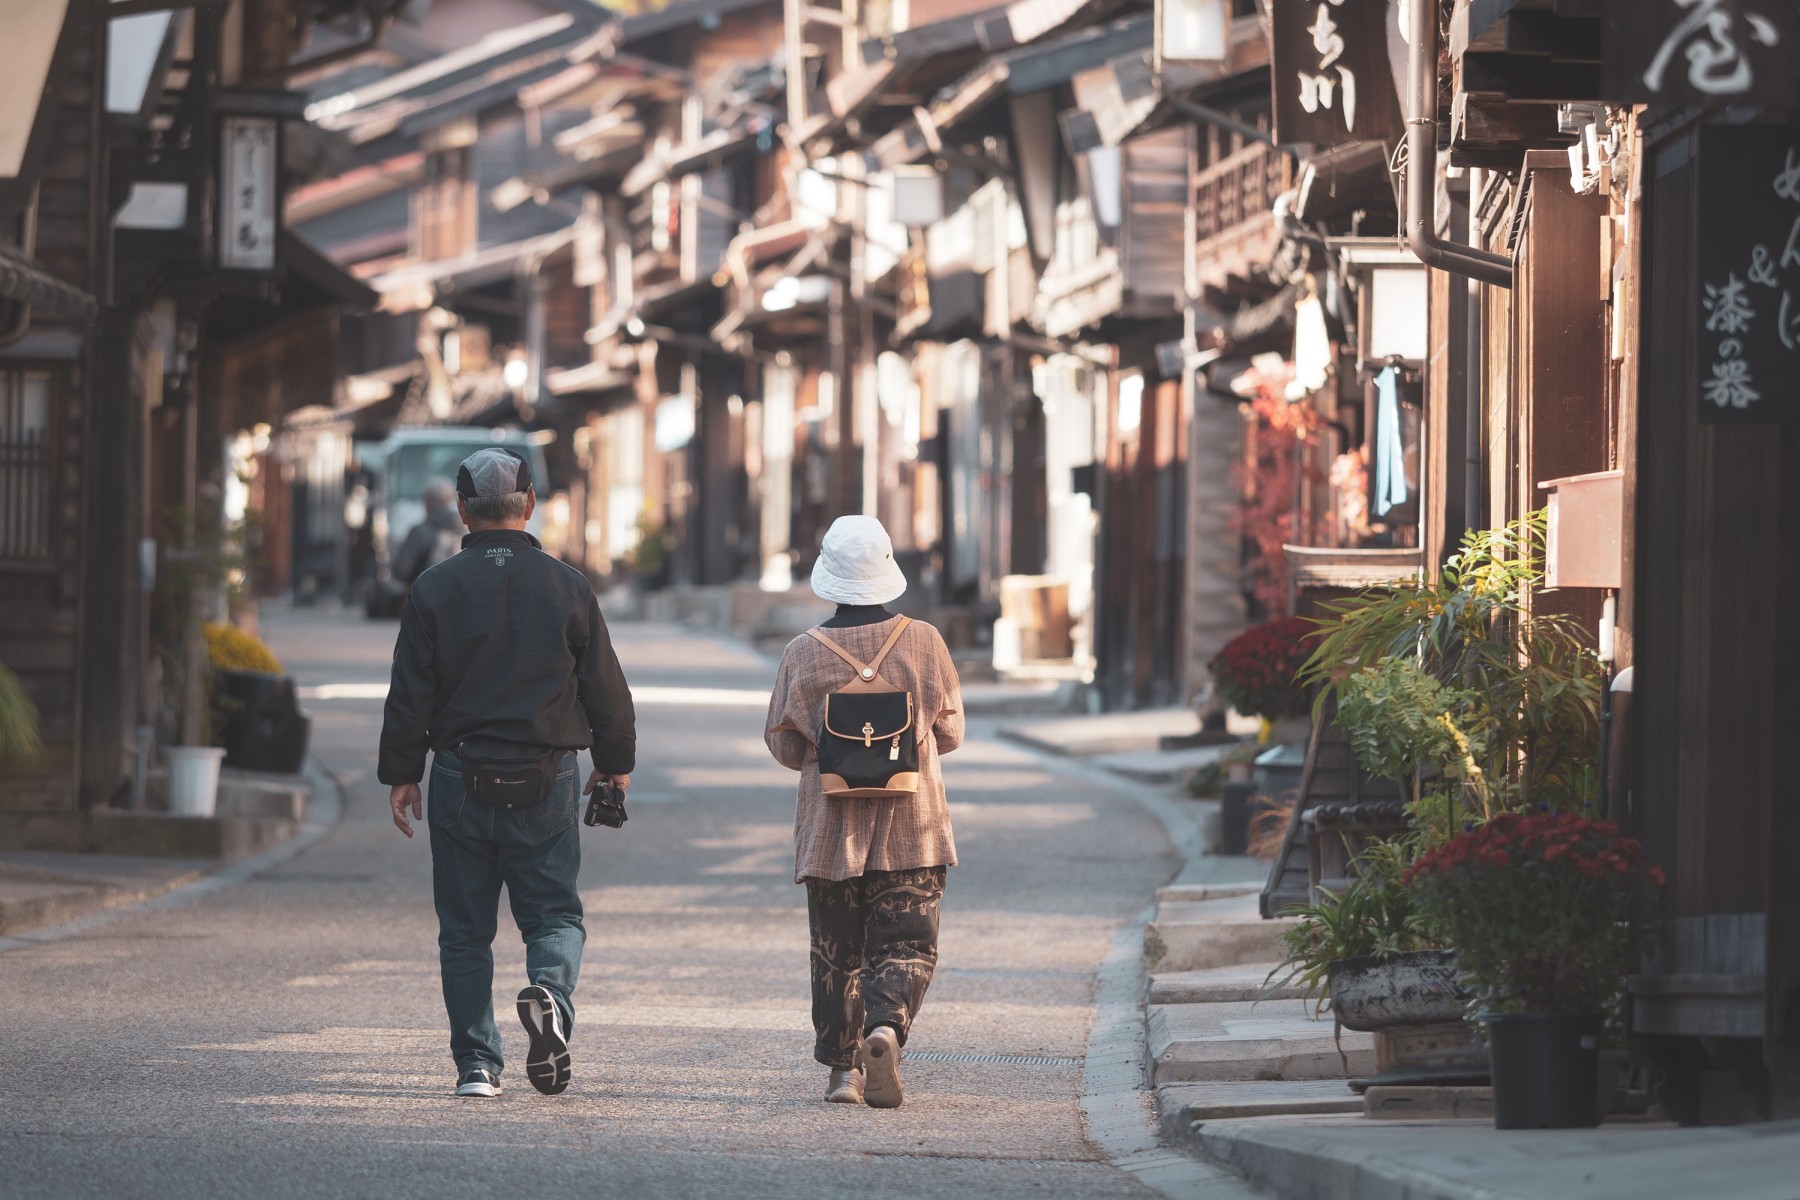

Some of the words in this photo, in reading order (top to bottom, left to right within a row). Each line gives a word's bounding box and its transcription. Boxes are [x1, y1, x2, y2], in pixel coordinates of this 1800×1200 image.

[1748, 244, 1779, 288] &
[1701, 271, 1761, 409] 漆の器
